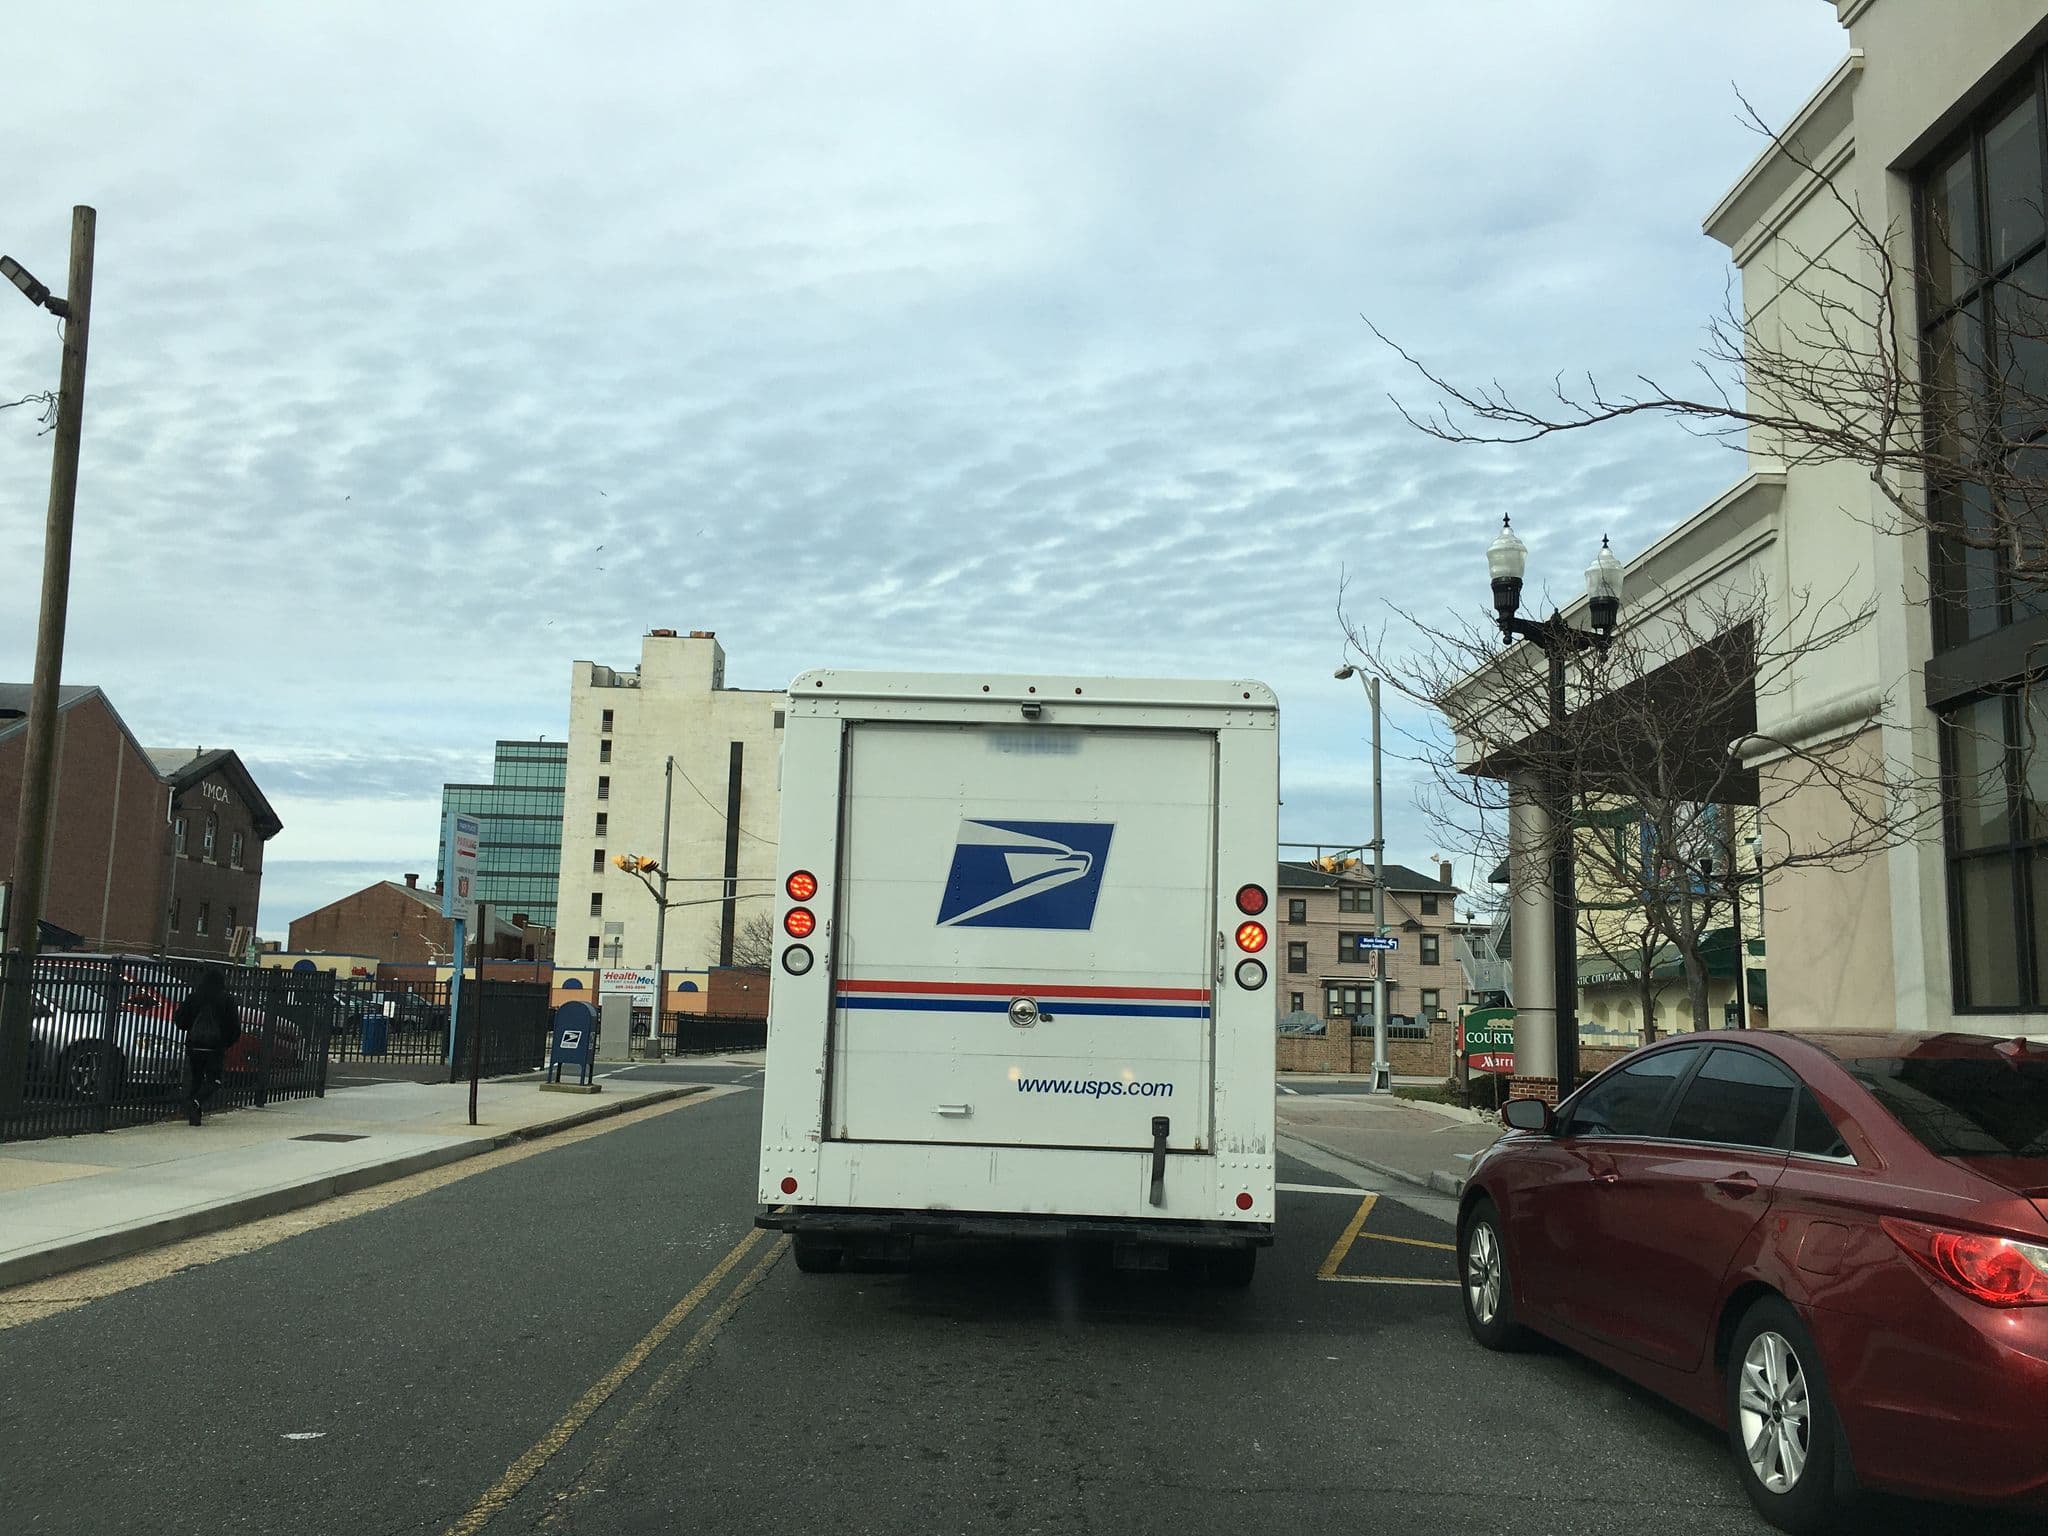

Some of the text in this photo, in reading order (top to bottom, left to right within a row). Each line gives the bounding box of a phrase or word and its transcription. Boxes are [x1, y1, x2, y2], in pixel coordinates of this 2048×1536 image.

[202, 780, 230, 804] YMCA
[604, 971, 638, 980] Health
[1592, 973, 1605, 983] CITY
[1466, 1032, 1514, 1045] COURTY
[1481, 1055, 1513, 1068] Marri
[1017, 1078, 1174, 1099] www.usps.com
